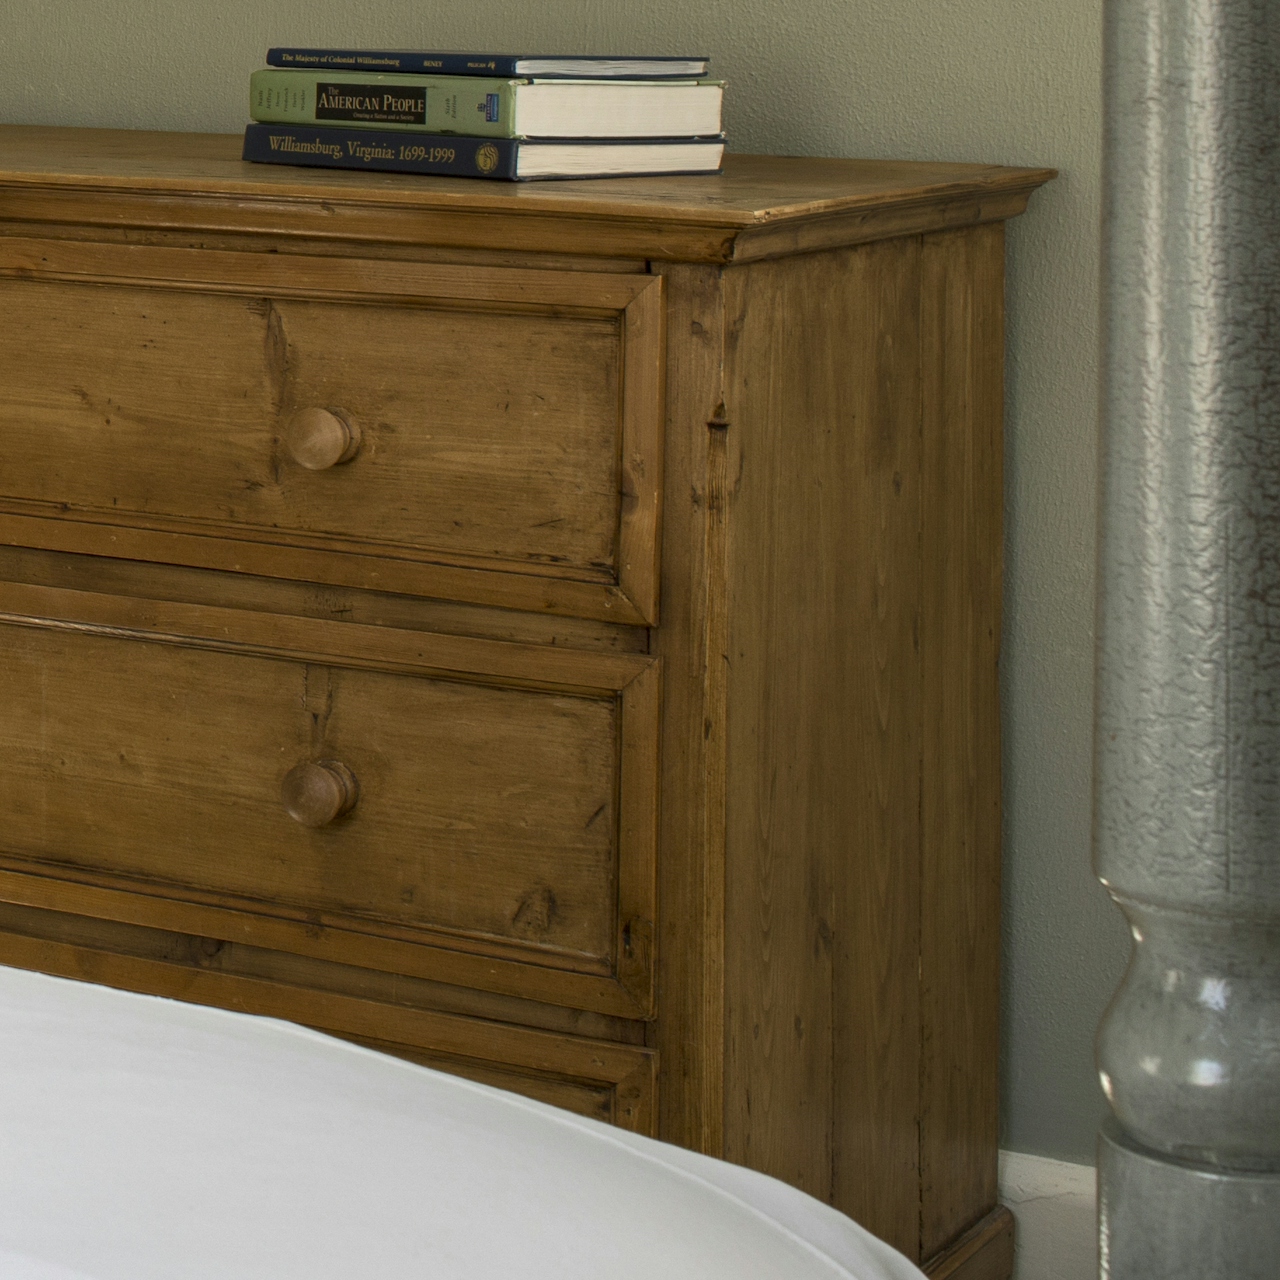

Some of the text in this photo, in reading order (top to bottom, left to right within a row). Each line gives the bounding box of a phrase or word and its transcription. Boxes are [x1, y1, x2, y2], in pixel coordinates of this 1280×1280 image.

[282, 53, 294, 61] The
[295, 54, 319, 64] Majesty
[328, 55, 356, 64] Colonial
[357, 56, 400, 67] Williamsburg
[423, 60, 443, 68] BENEY
[328, 86, 340, 95] The
[318, 92, 425, 112] AMERICAN PEOPLE
[353, 111, 370, 119] Creating
[400, 113, 414, 121] Society
[268, 135, 343, 160] Williamsburg,
[347, 140, 395, 162] Virginia:
[399, 145, 455, 163] 1699-1999
